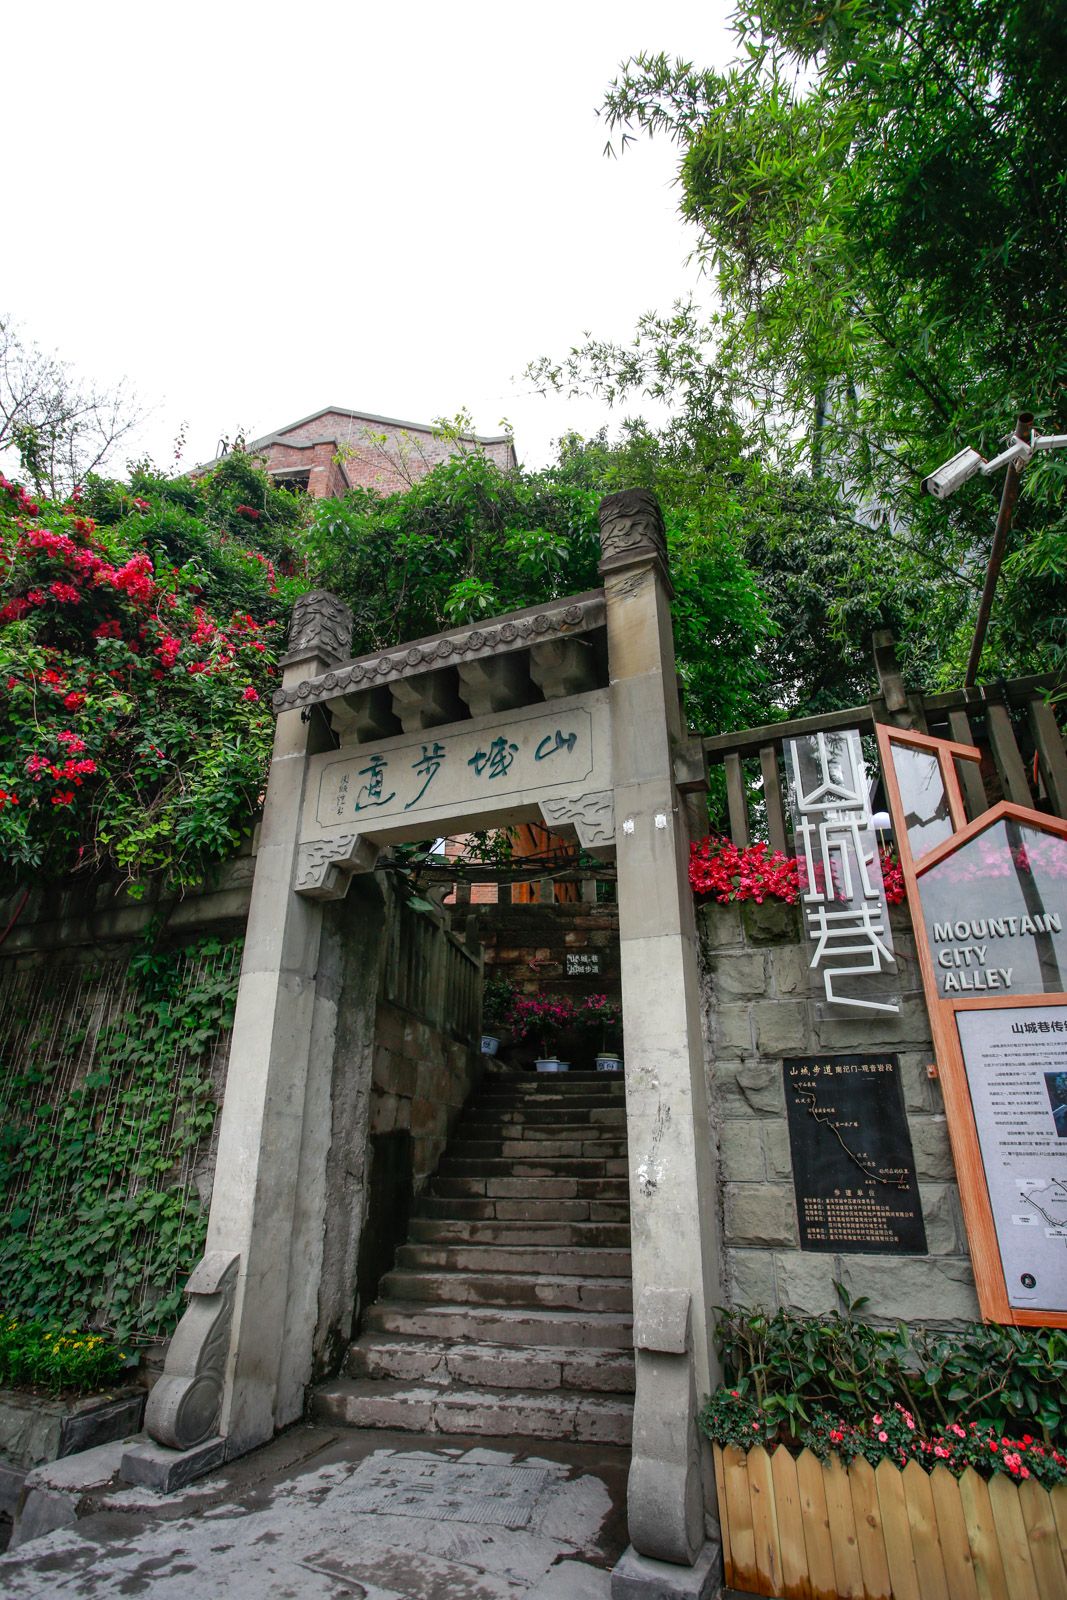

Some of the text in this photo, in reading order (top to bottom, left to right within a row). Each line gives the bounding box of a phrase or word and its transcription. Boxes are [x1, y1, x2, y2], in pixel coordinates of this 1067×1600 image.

[790, 731, 900, 1012] 山城巷
[933, 912, 1062, 942] MOUNTAIN
[938, 945, 987, 968] CITY
[944, 968, 1013, 992] ALLEY
[1011, 1020, 1067, 1034] 山城巷传
